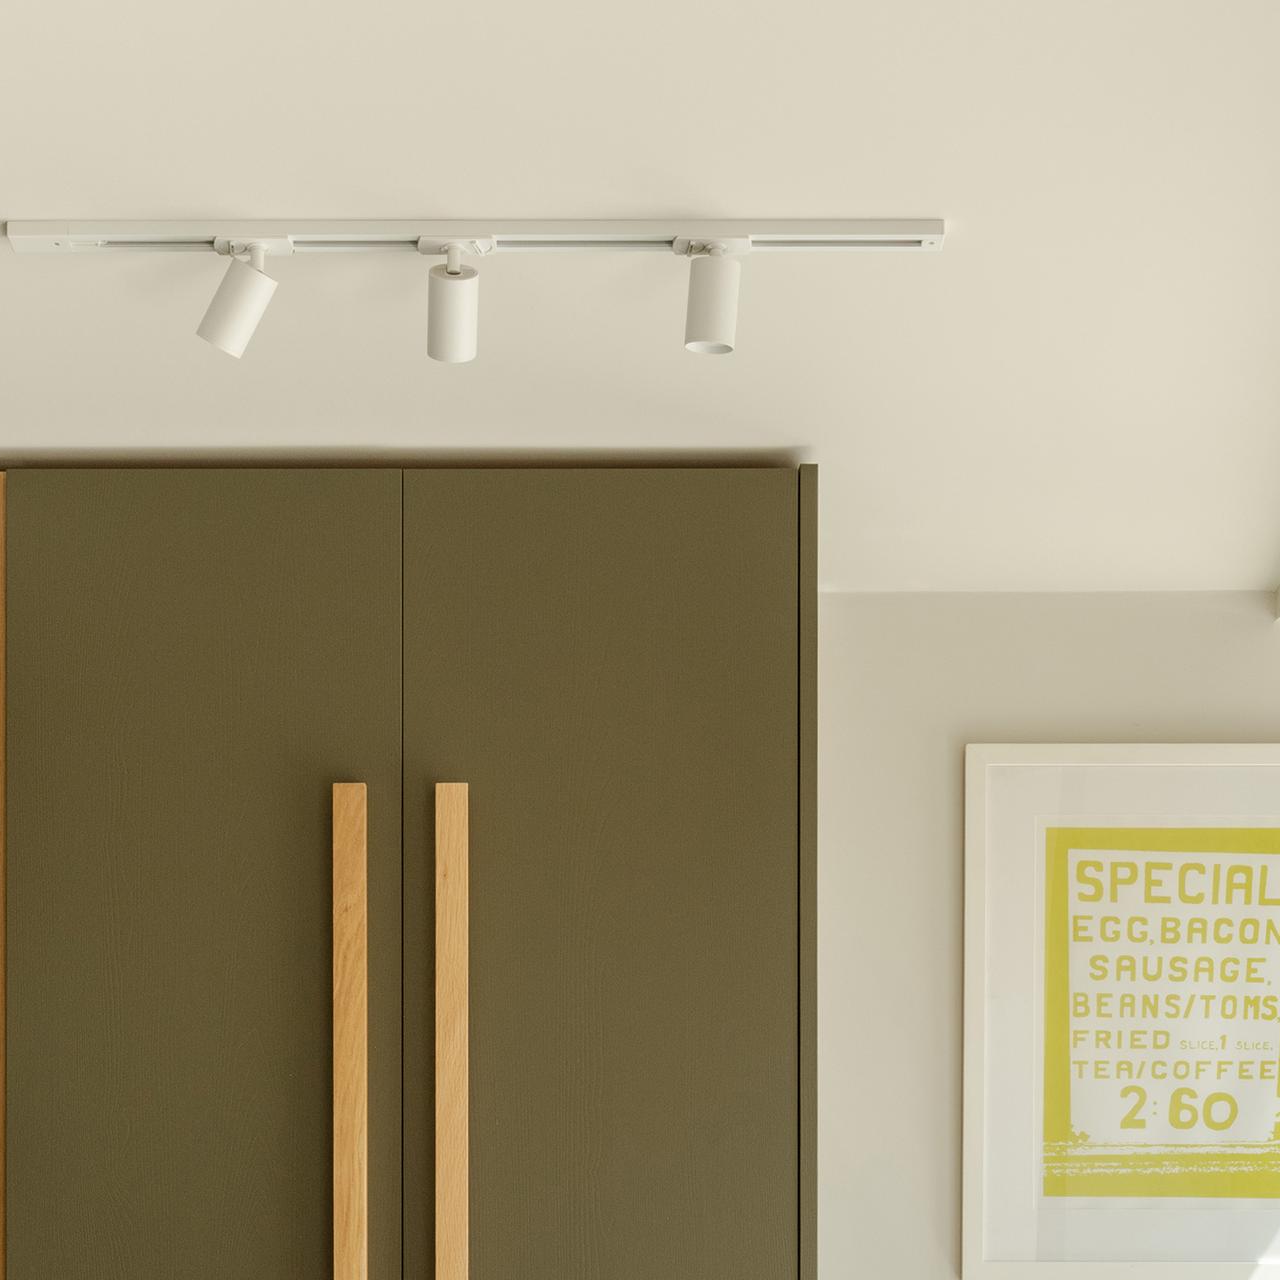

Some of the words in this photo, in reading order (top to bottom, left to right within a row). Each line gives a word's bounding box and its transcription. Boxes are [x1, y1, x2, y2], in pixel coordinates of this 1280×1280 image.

[1072, 1030, 1170, 1049] FRIED
[1219, 1035, 1227, 1049] 1
[1072, 1060, 1277, 1080] TEA/COFFEE
